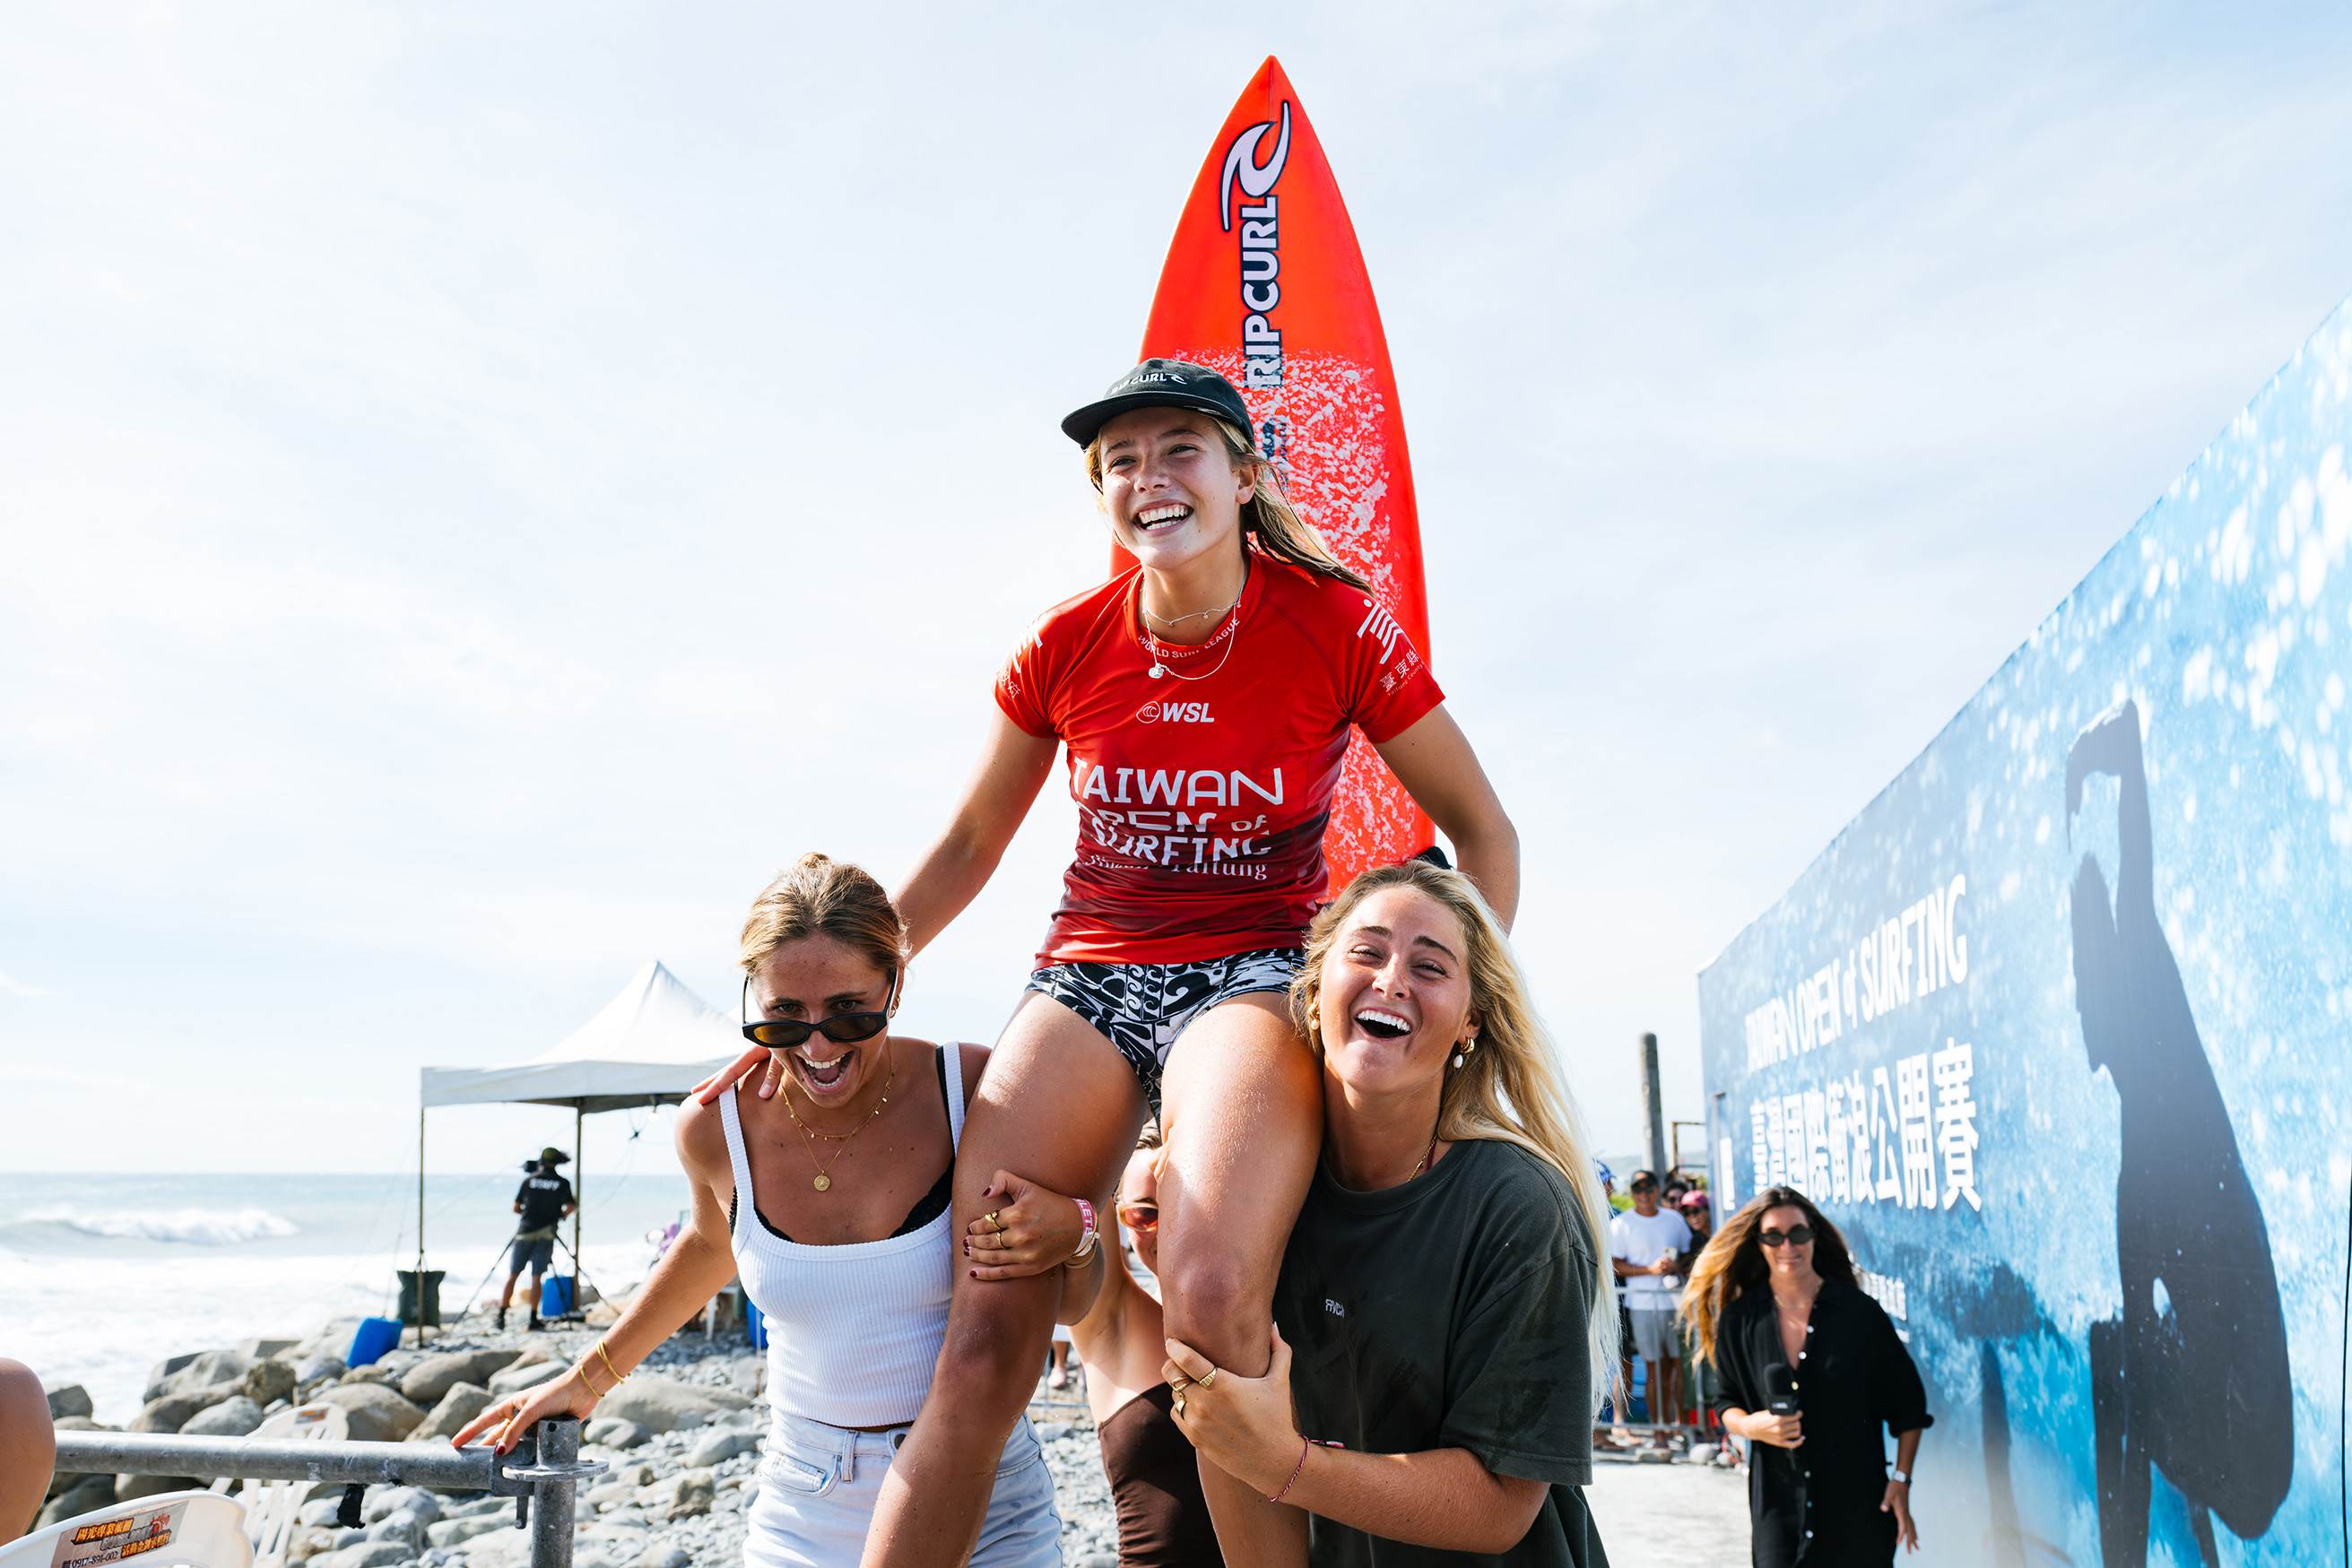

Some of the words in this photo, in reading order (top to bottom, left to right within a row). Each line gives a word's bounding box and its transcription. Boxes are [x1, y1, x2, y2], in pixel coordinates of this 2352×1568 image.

[1162, 702, 1215, 723] WSL
[1073, 756, 1283, 807] TAIWAN
[1231, 814, 1267, 833] of
[1796, 957, 1843, 1053] OPEN
[1861, 873, 1968, 1023] SURFING
